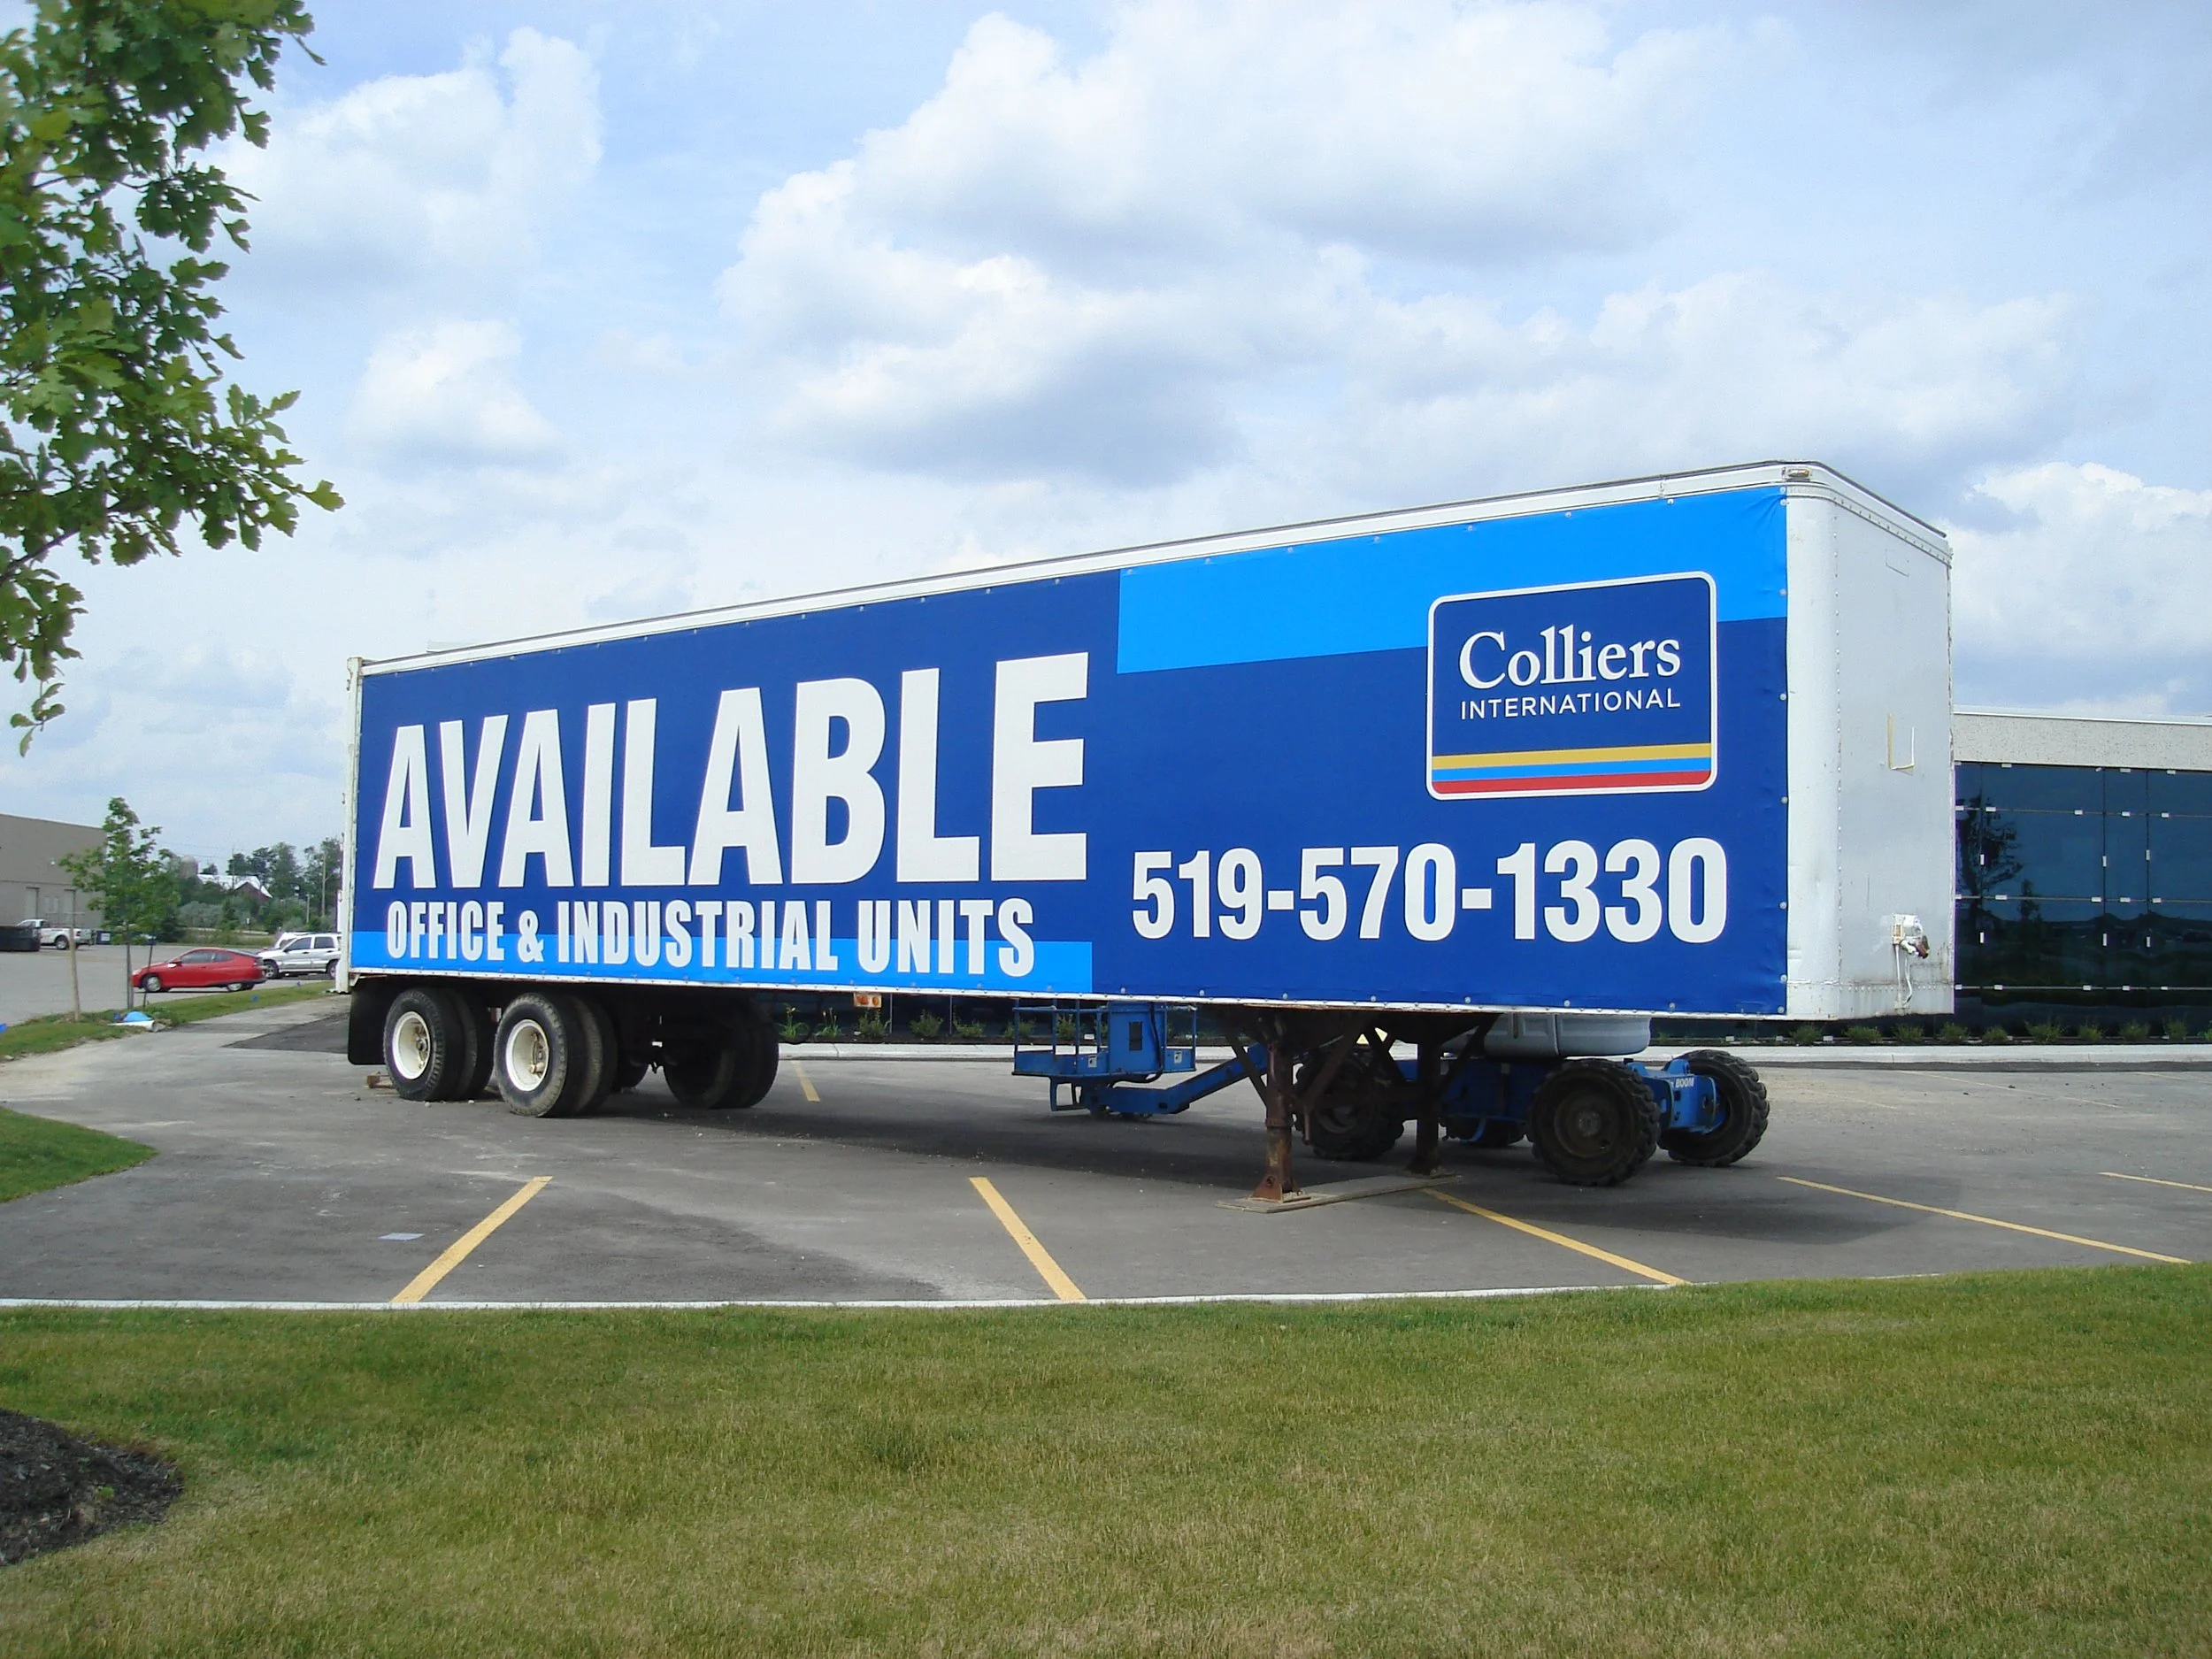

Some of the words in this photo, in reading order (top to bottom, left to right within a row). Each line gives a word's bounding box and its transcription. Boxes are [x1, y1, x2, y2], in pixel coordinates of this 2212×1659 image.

[1459, 624, 1681, 689] Colliers
[1461, 687, 1681, 720] INTERNATIONAL
[373, 651, 1089, 889] AVAILABLE
[1133, 837, 1727, 943] 519-570-1330
[386, 900, 504, 961] OFFICE
[517, 910, 544, 963] &
[557, 899, 838, 972] INDUSTRIAL
[857, 897, 1034, 978] UNITS
[1675, 1077, 1694, 1088] BOOM
